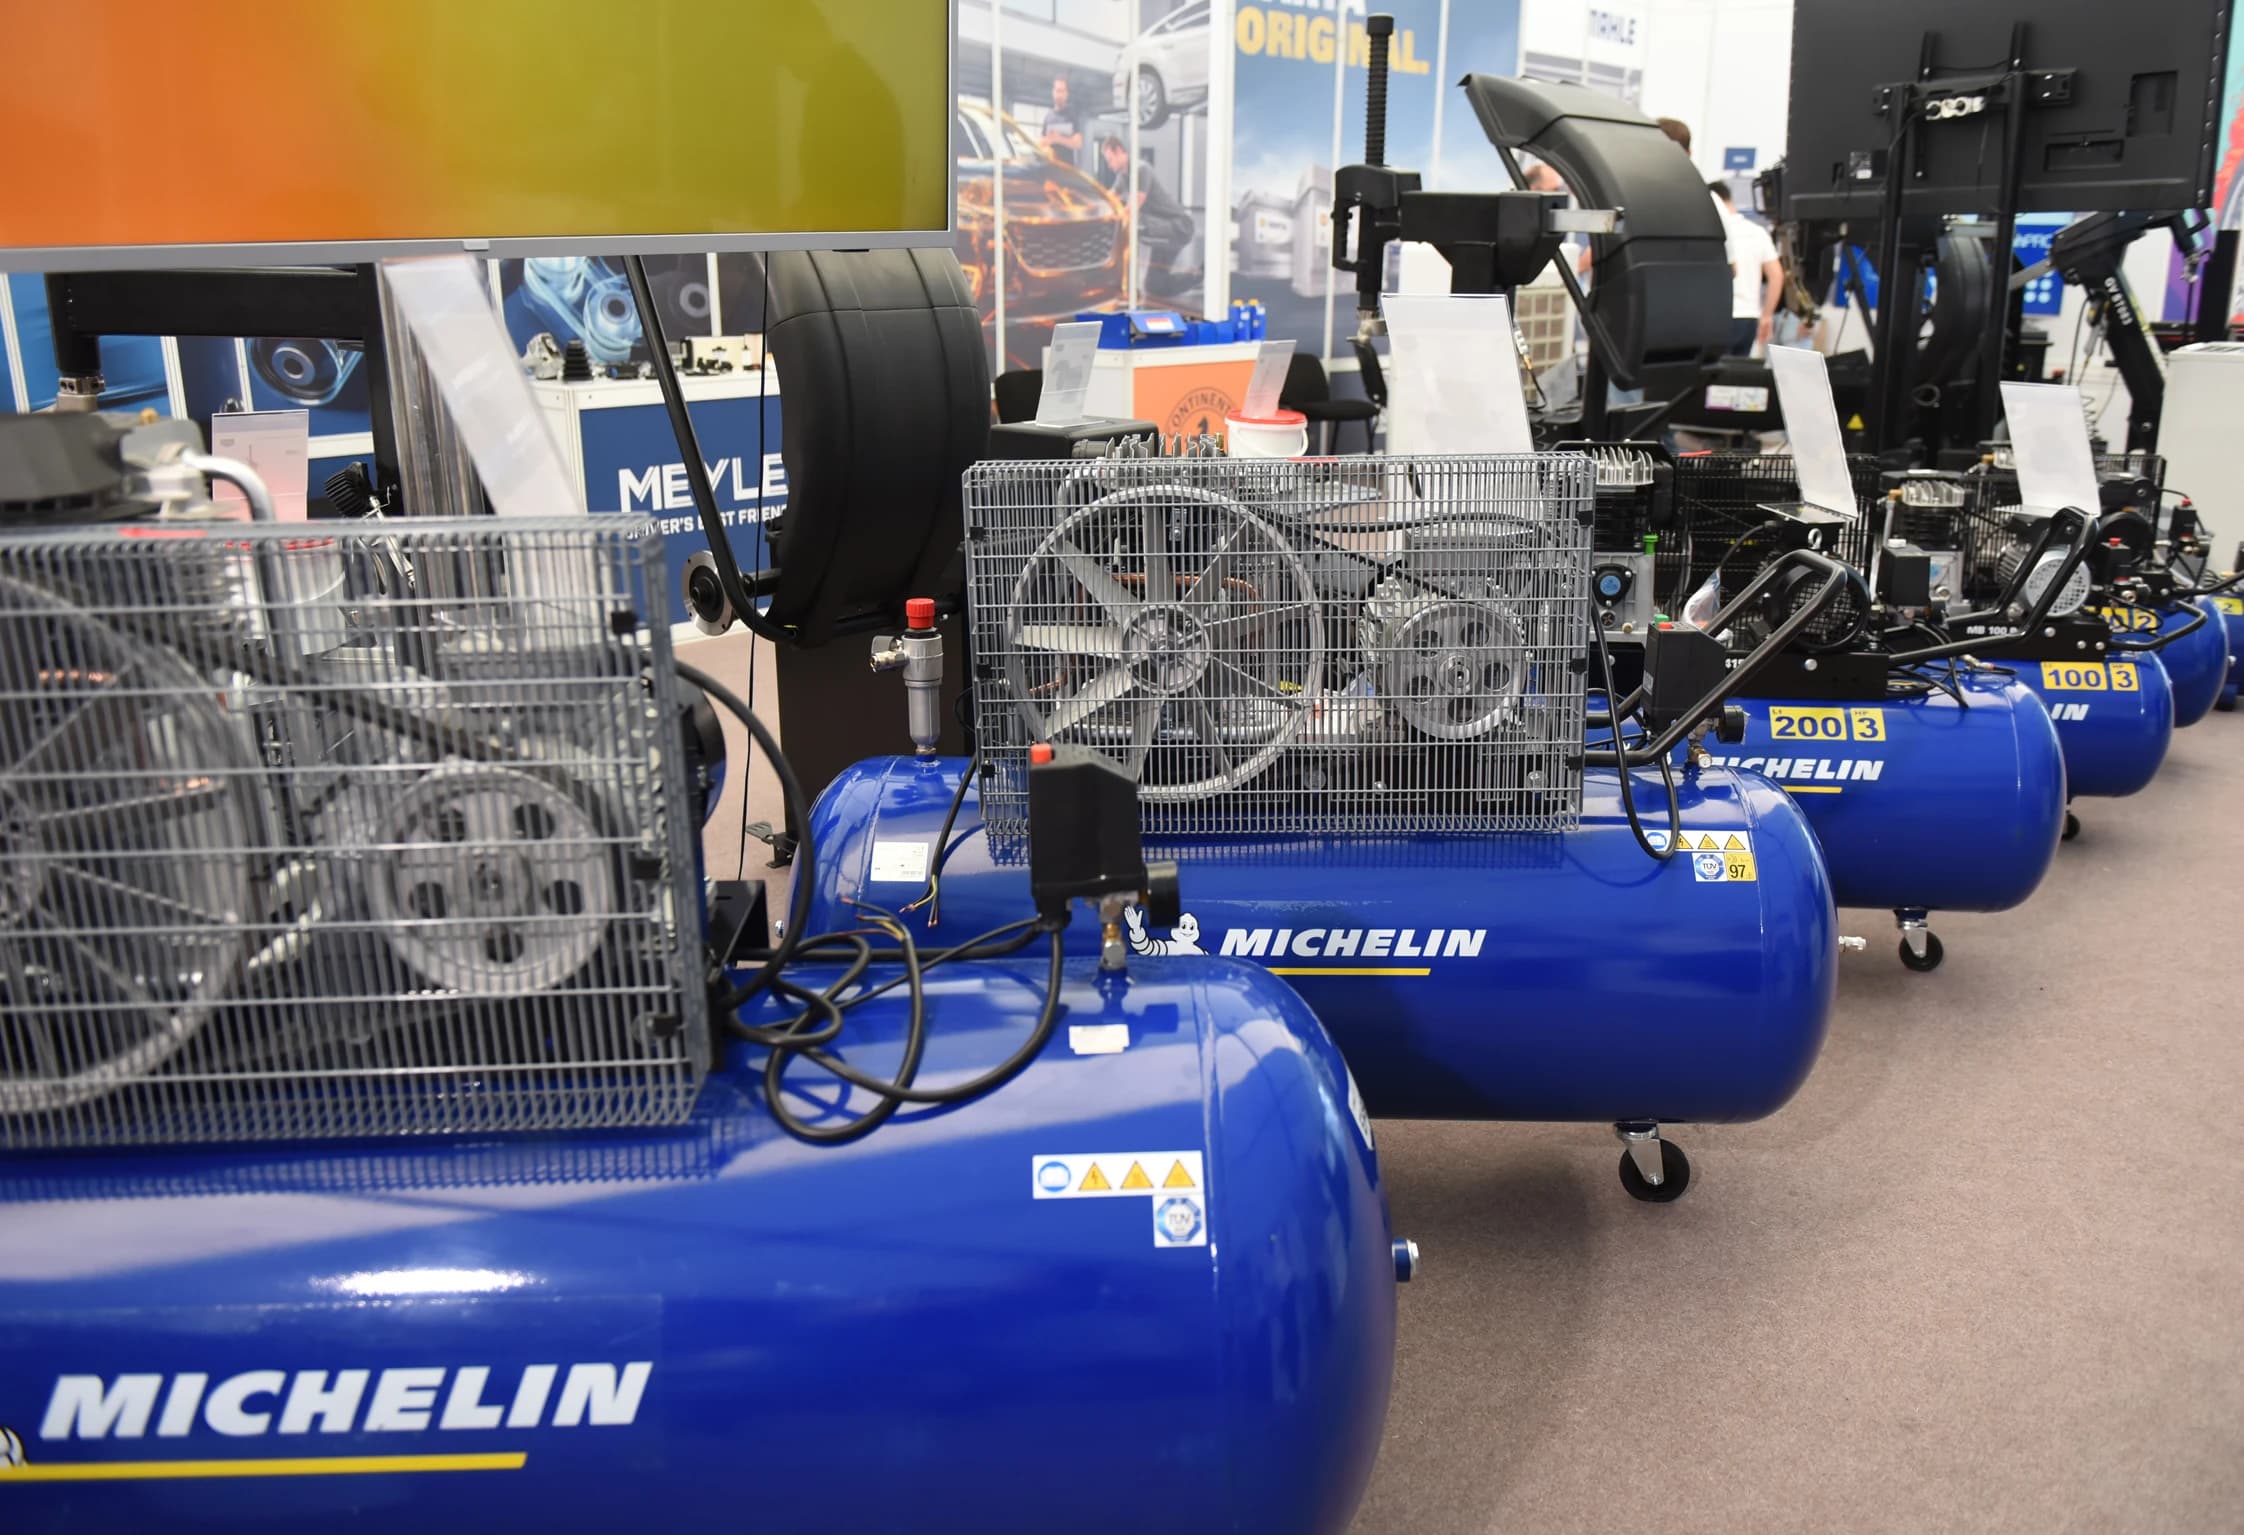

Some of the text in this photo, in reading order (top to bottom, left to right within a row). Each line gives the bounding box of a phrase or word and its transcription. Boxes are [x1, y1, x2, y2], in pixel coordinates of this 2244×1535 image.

[2048, 669, 2134, 688] 100 3
[1775, 716, 1880, 739] 200 3
[1729, 864, 1747, 879] 97
[1219, 928, 1487, 957] MICHELIN
[39, 1361, 653, 1441] MICHELIN
